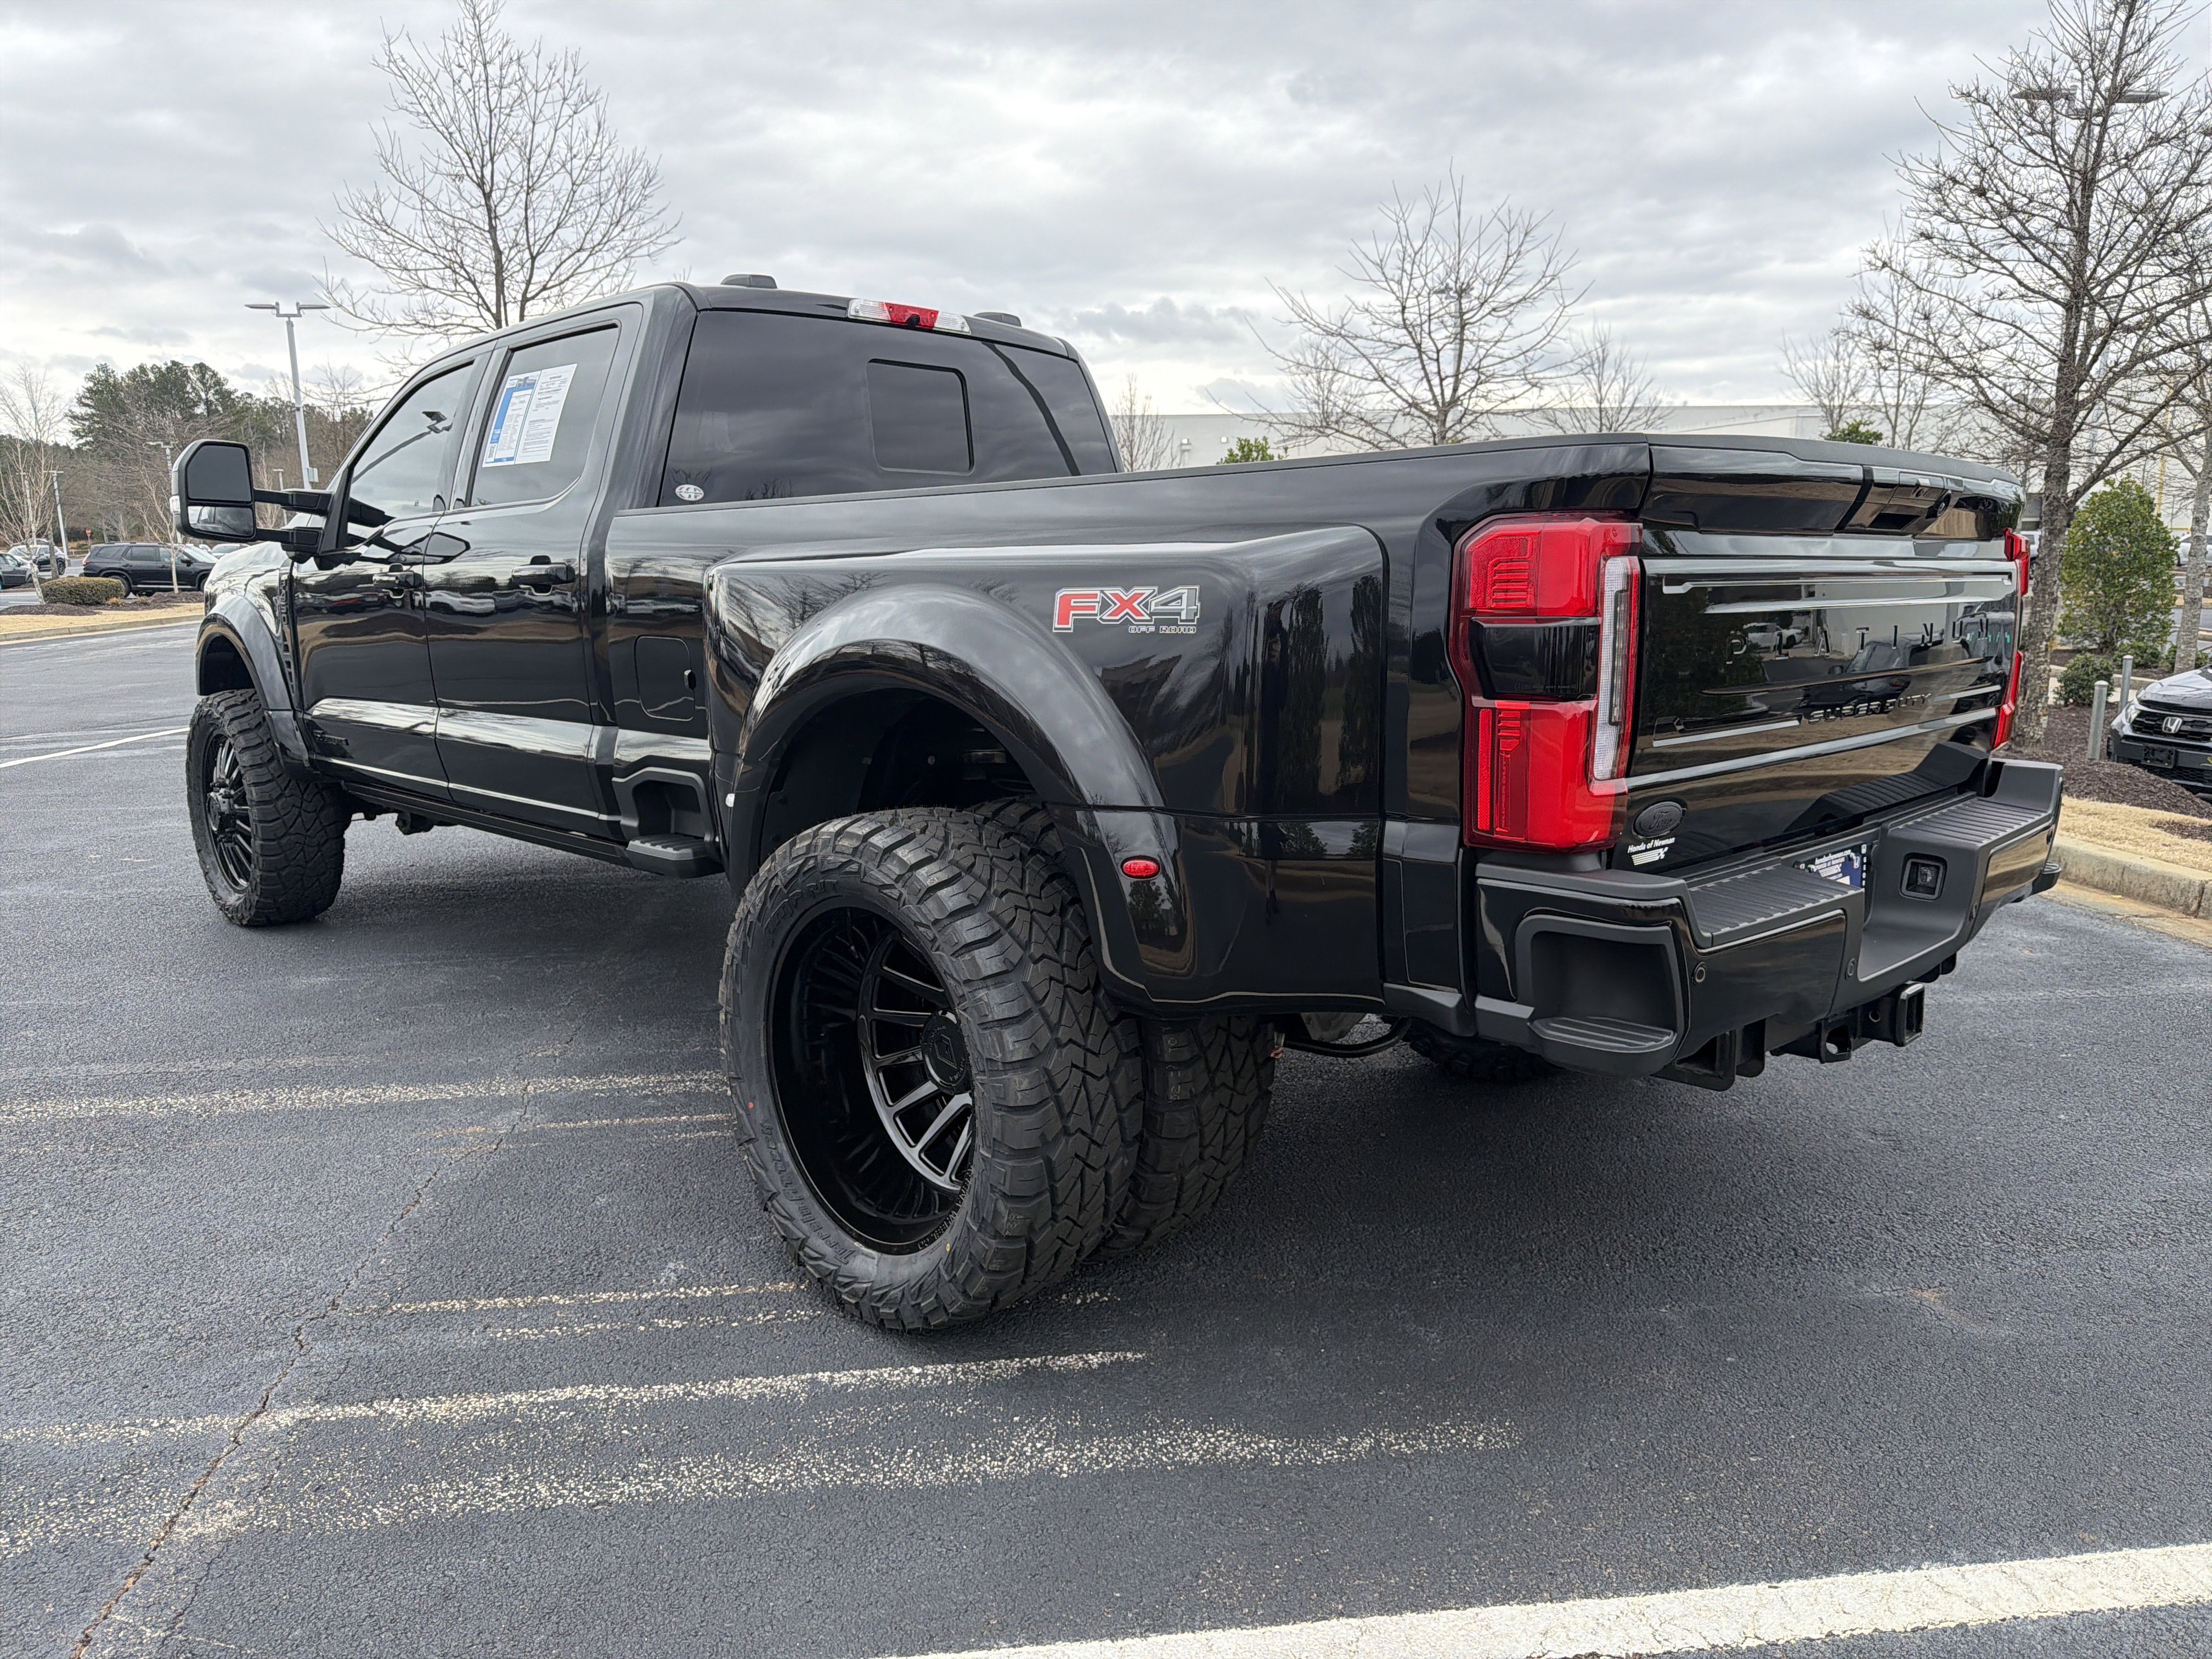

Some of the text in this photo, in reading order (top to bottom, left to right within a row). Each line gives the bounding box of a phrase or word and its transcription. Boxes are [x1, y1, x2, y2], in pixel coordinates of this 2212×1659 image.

[1053, 585, 1200, 632] FX4
[1128, 625, 1155, 634] OFF
[1726, 618, 1989, 665] PLATINUM
[1627, 837, 1675, 854] Honda of Newnan
